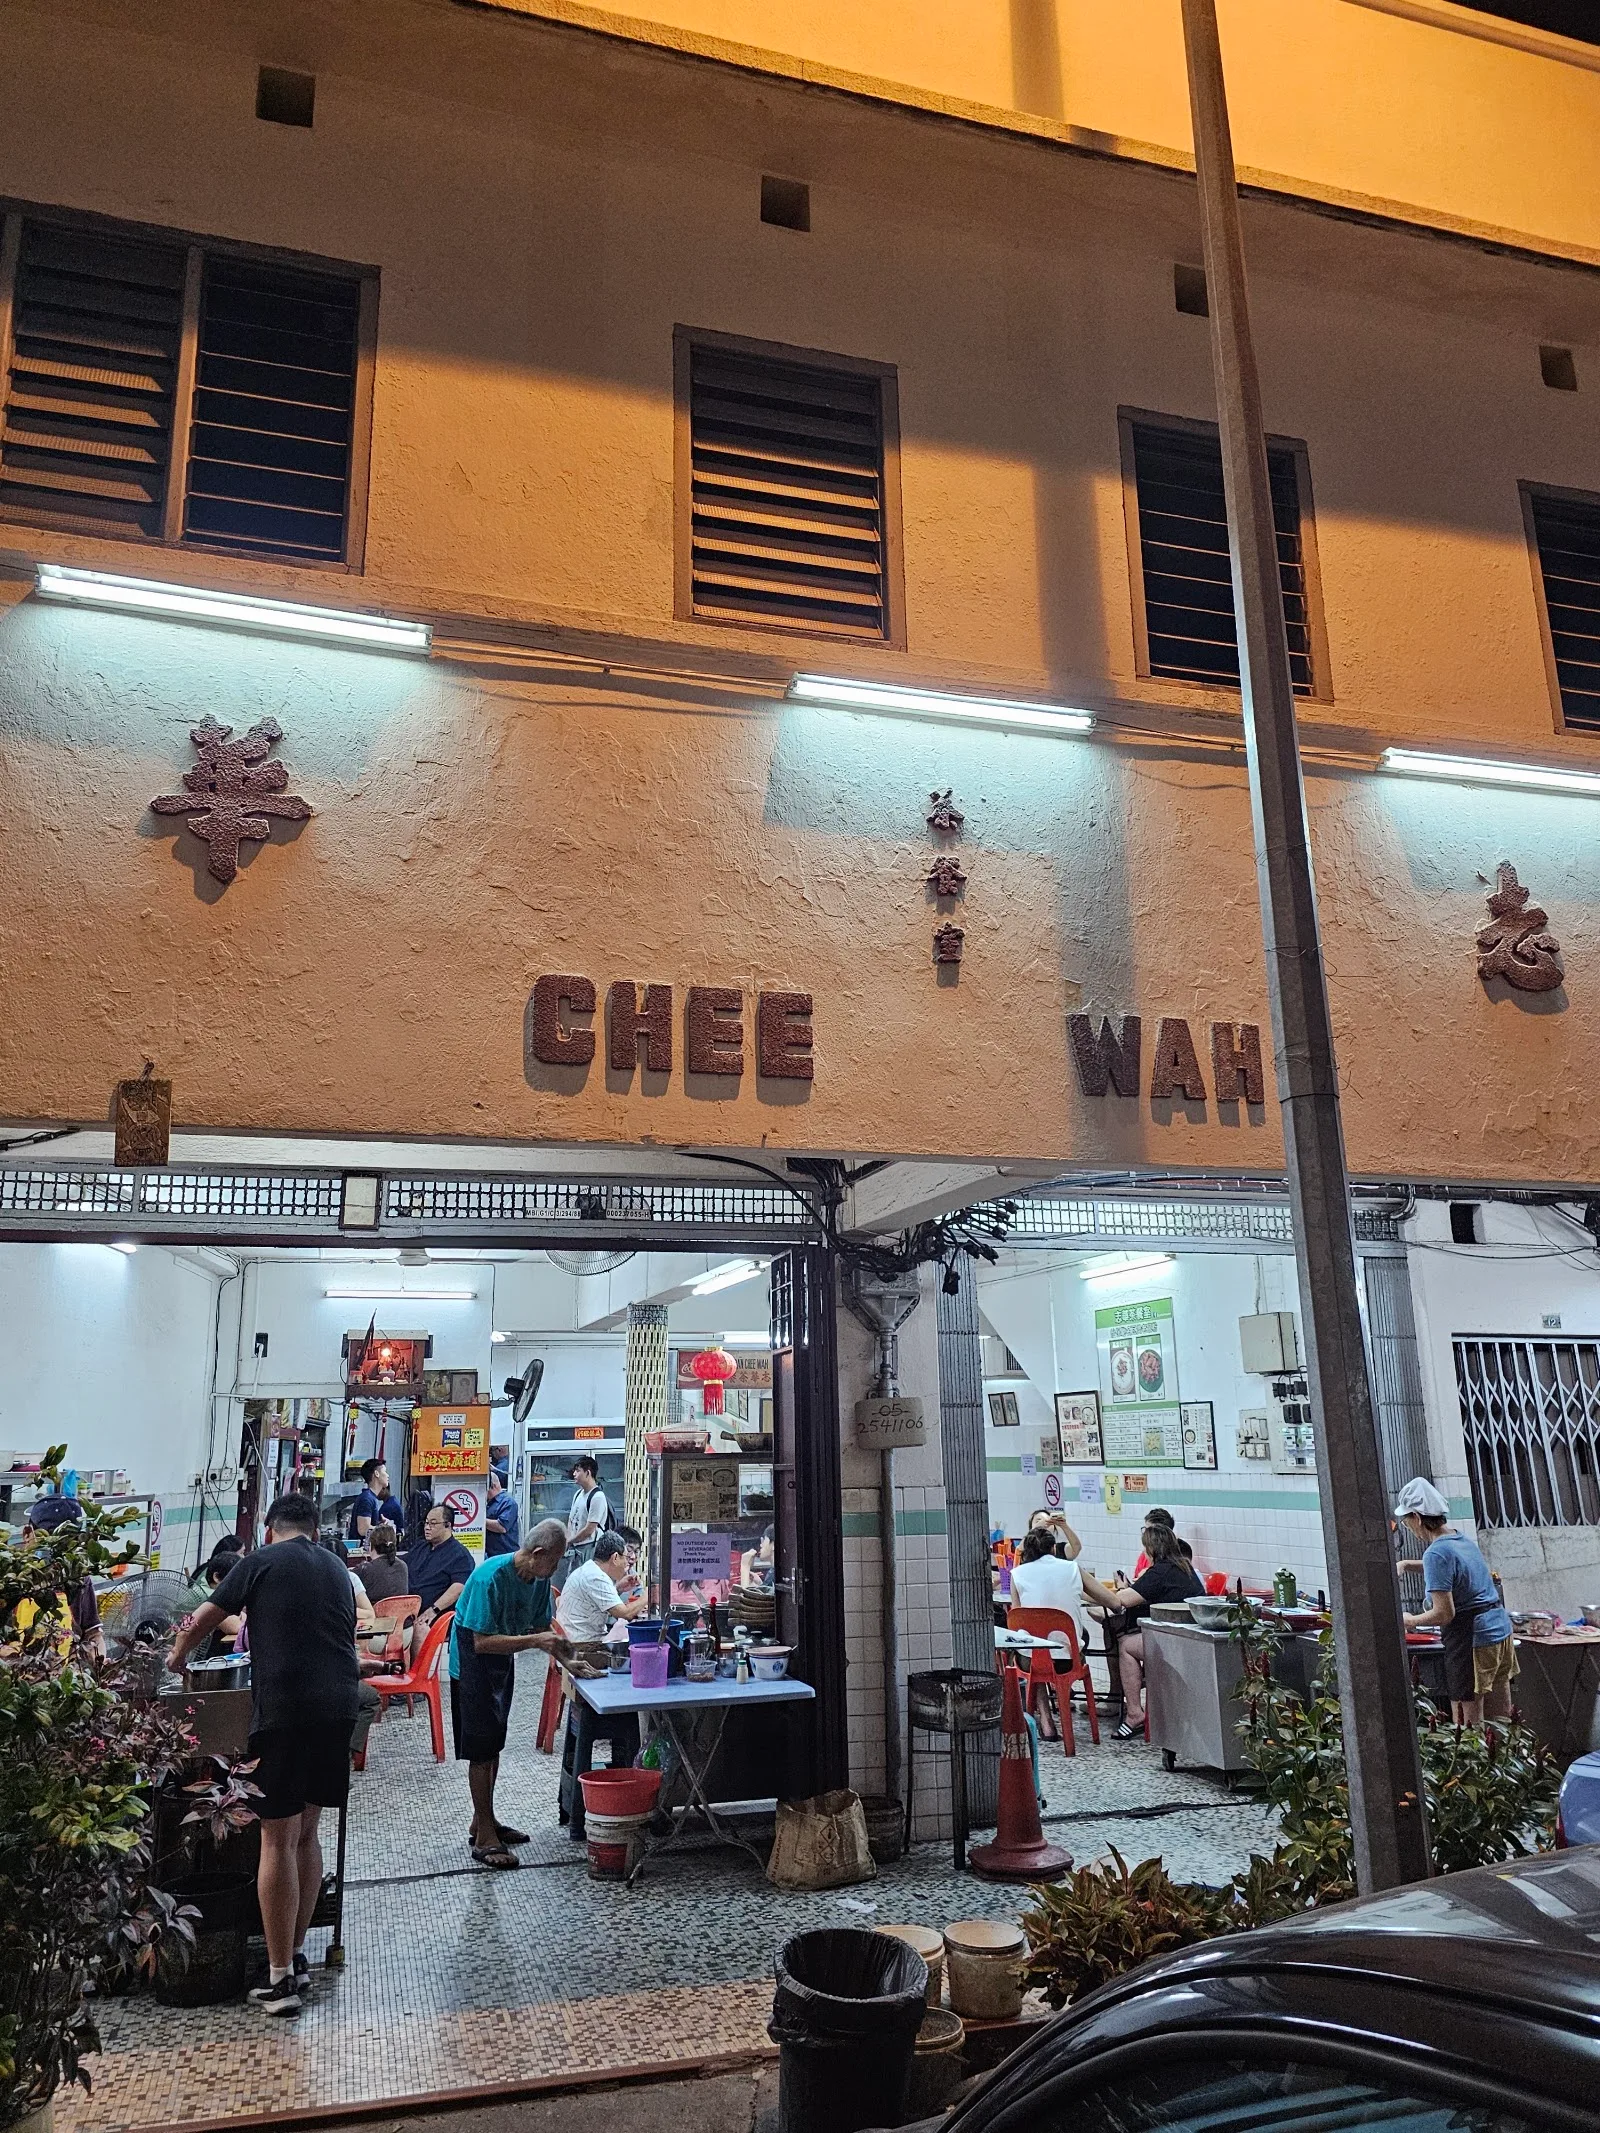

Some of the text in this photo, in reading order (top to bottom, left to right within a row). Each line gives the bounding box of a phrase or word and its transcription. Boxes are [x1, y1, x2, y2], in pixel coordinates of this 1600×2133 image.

[1475, 858, 1564, 992] 志
[532, 973, 1264, 1104] CHEE WAH
[757, 1358, 769, 1369] WAH
[857, 1416, 924, 1434] 2541106
